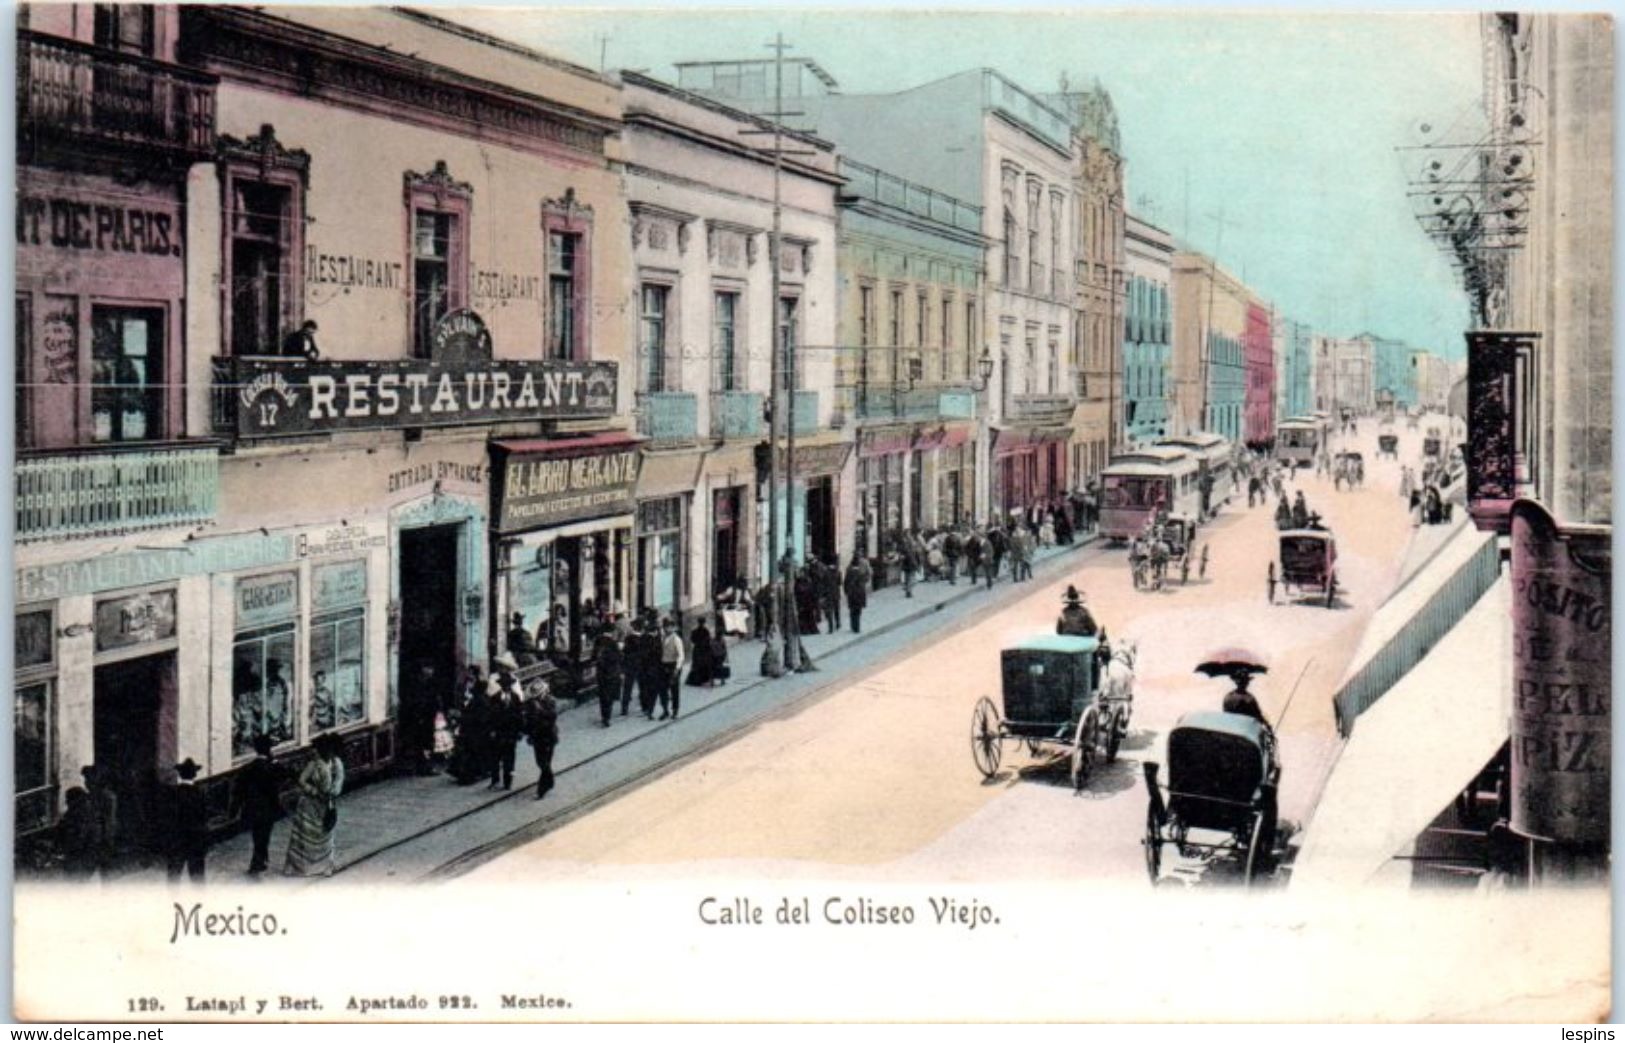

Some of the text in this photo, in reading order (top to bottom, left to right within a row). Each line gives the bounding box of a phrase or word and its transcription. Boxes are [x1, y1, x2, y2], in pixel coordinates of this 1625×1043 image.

[51, 200, 92, 248] DE
[95, 205, 180, 257] PARIS.
[307, 244, 402, 290] RESTAURANT
[260, 403, 278, 426] 17
[308, 372, 584, 420] RESTAURANT
[388, 460, 482, 494] ENTRADA ENTRANCE
